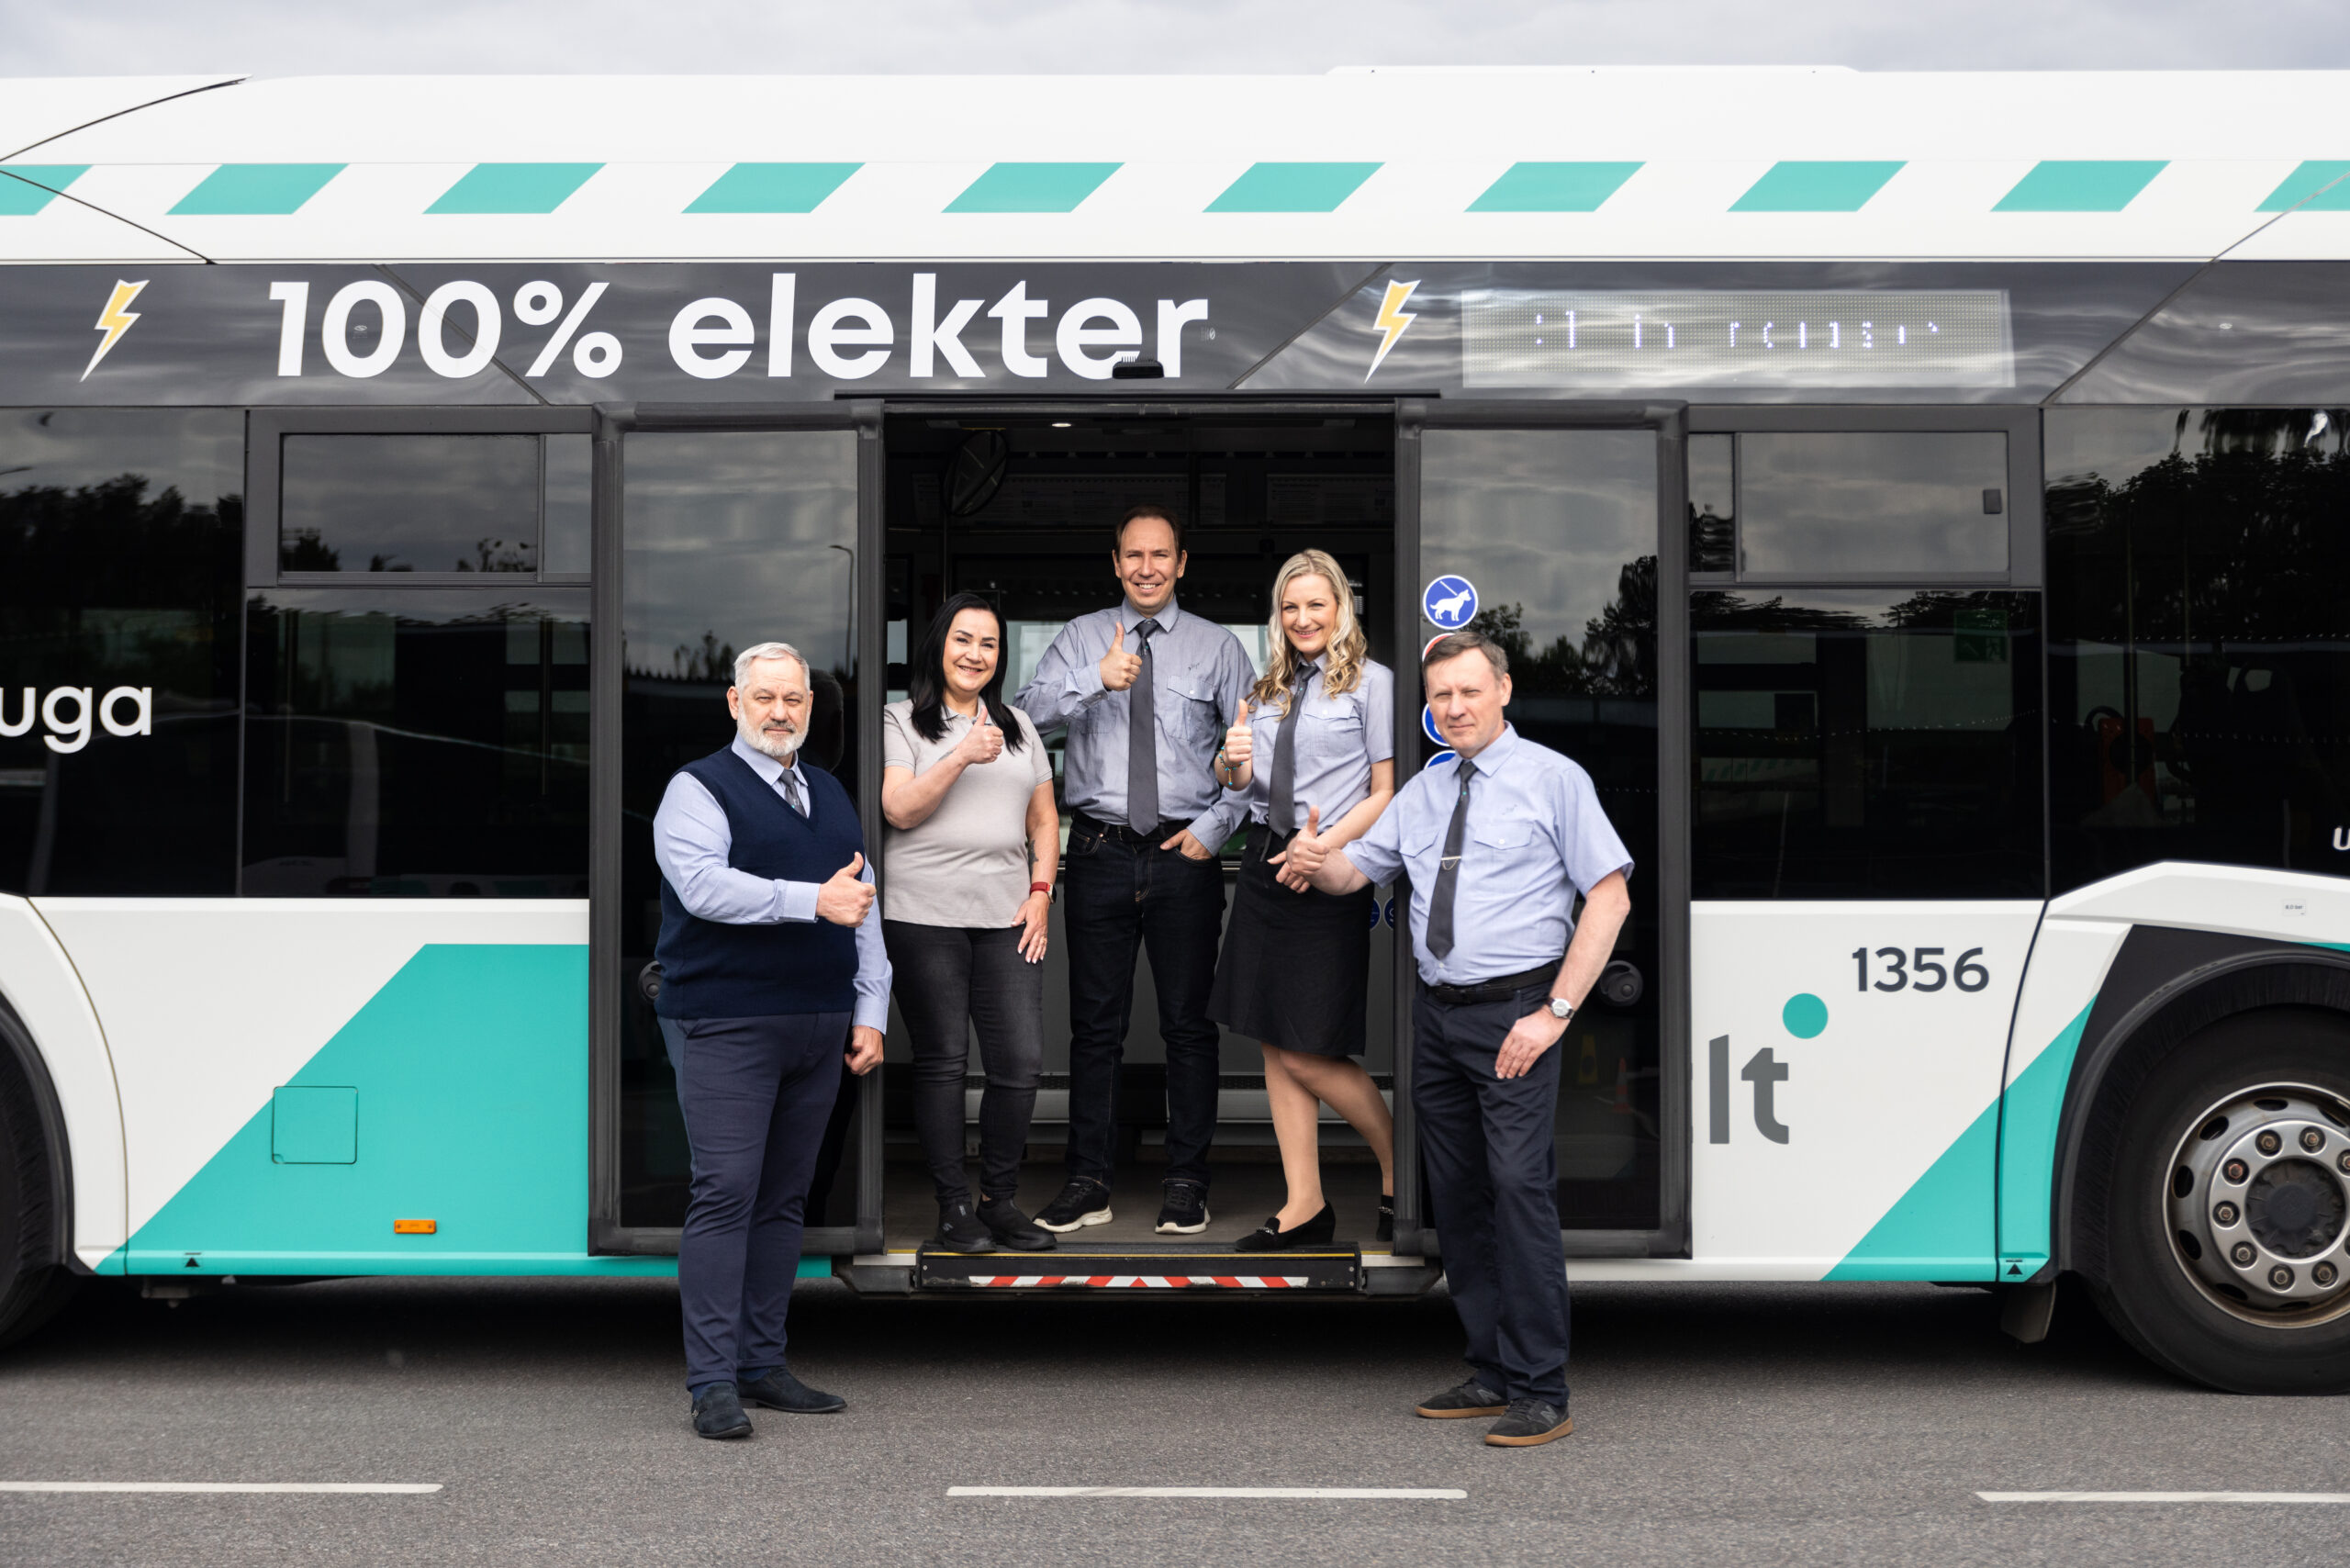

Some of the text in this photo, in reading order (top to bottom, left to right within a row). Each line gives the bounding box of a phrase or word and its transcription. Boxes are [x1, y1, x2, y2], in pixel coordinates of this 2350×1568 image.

[269, 273, 1209, 380] 100% elekter
[0, 686, 152, 754] uga
[1852, 946, 1989, 993] 1356
